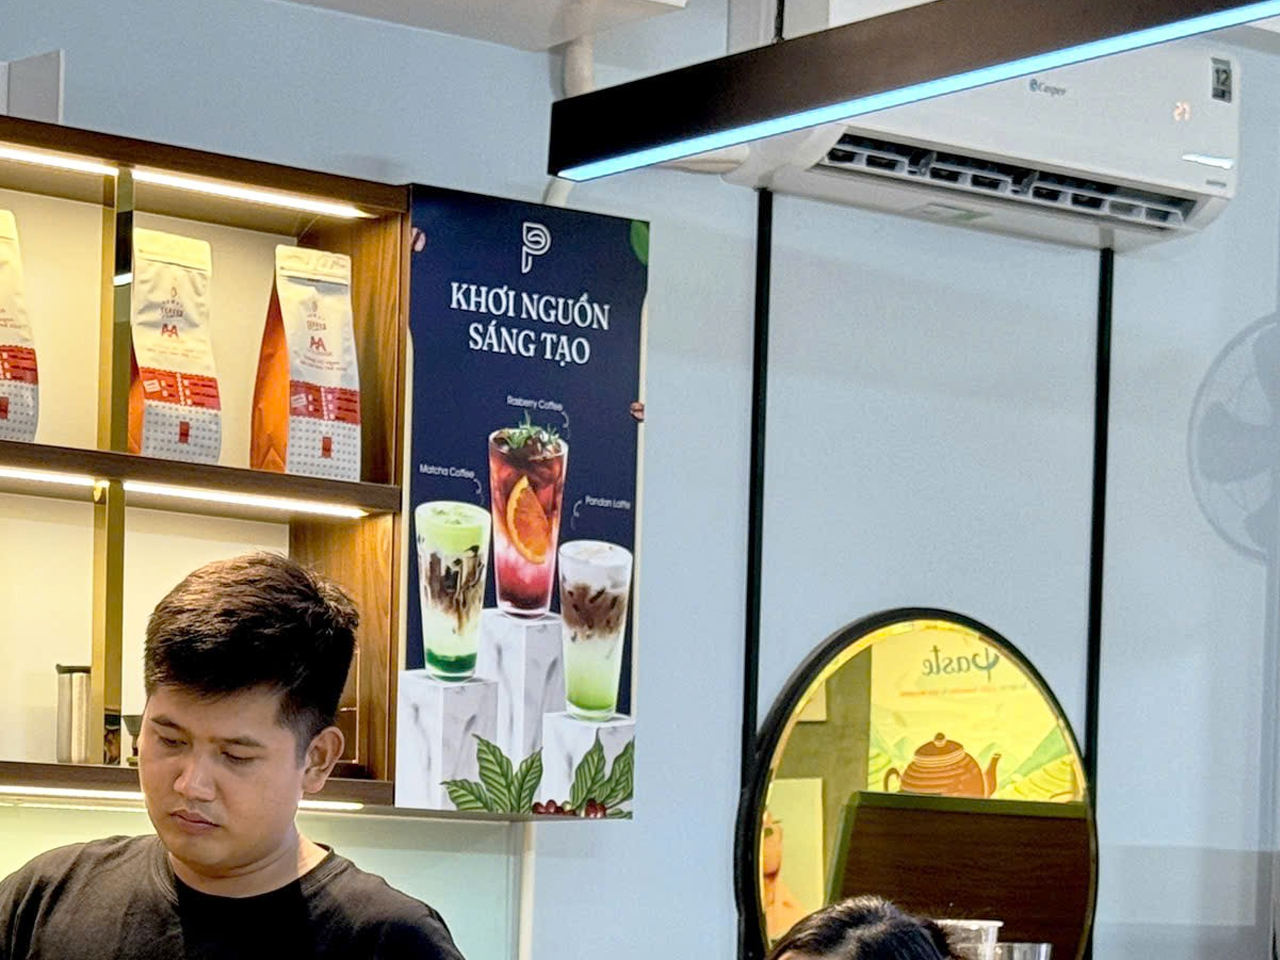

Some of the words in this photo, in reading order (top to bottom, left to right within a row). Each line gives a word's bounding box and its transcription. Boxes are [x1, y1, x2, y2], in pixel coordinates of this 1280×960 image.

[450, 282, 516, 317] KHƠI
[469, 319, 537, 357] SÁNG
[540, 332, 591, 367] TẠO
[419, 464, 449, 476] Matcha
